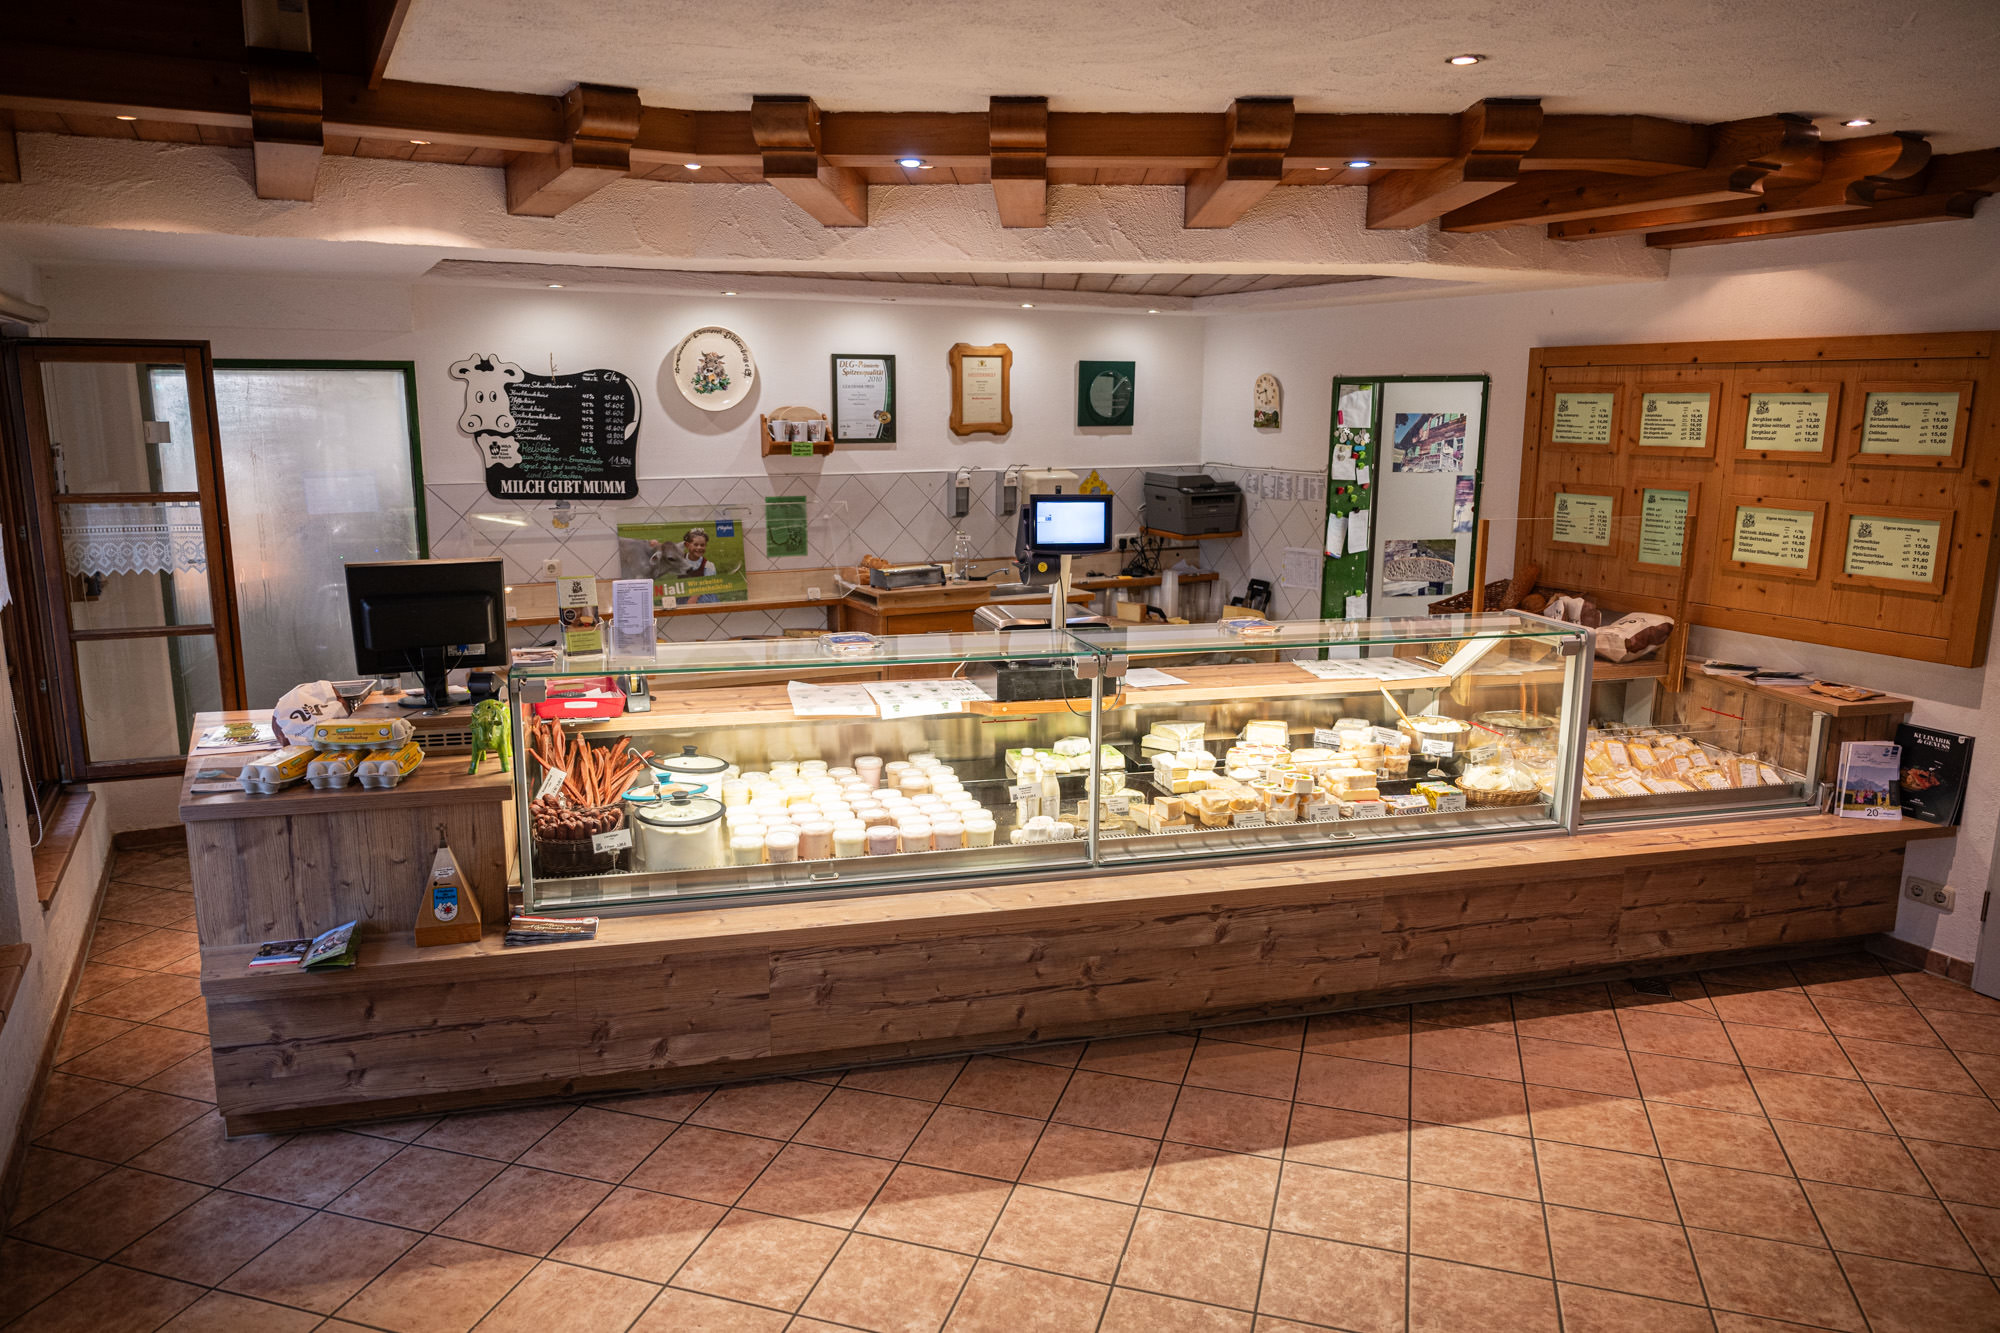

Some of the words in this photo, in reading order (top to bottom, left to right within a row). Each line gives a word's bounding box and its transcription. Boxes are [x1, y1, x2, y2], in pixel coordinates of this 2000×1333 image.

[579, 446, 597, 454] 45%
[501, 480, 545, 494] MILCH
[548, 480, 581, 494] GIBT
[583, 480, 626, 494] MUMM
[1914, 732, 1951, 744] KULINARIK
[1923, 740, 1950, 750] GENUSS
